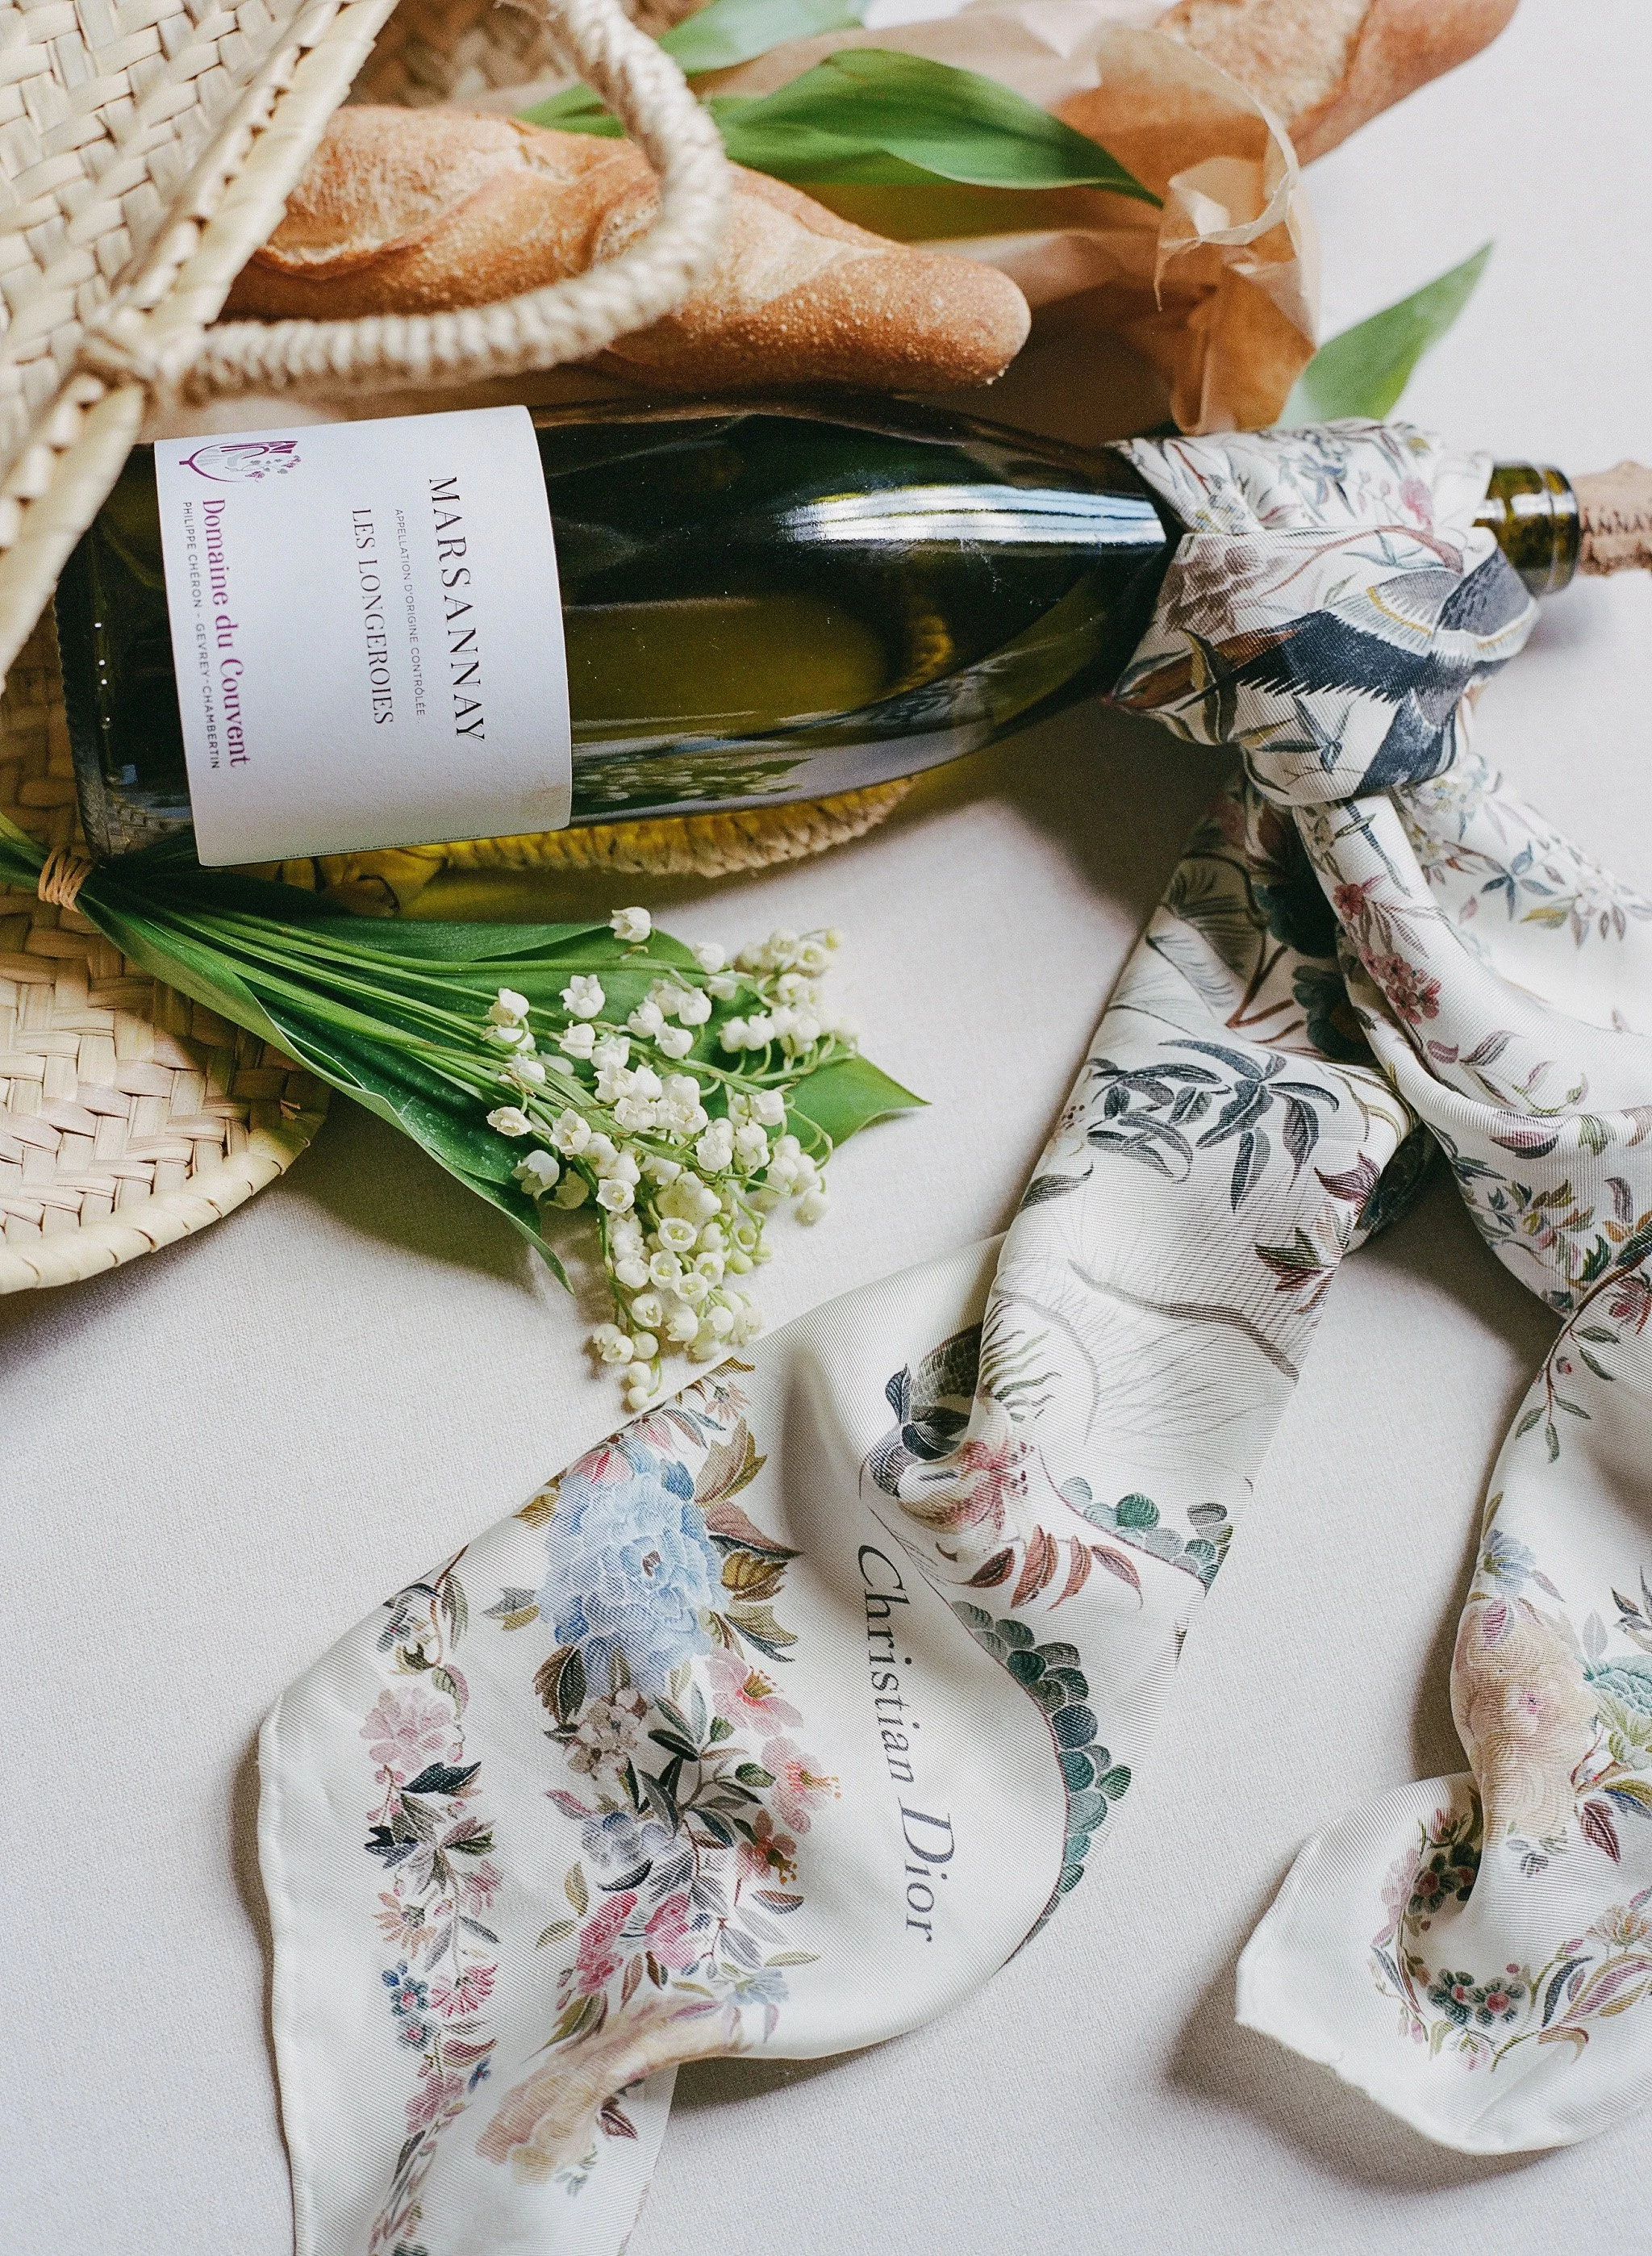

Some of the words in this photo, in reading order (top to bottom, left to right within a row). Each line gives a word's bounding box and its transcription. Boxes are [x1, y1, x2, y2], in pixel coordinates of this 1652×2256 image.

[183, 501, 196, 549] PHILIPPE
[202, 499, 230, 607] Domaine
[352, 508, 376, 549] LES
[187, 554, 202, 608] CHÉRON
[215, 615, 239, 649] du
[395, 509, 411, 581] APPELLATION
[403, 584, 419, 643] D'ORIGINE
[411, 647, 426, 716] CONTRÔLÉE
[428, 476, 486, 741] MARSANNAY
[195, 623, 219, 770] GEVREY-CHAMBERTIN
[357, 558, 394, 725] LONGEROIES
[220, 658, 251, 768] Couvent
[857, 1543, 920, 1783] Christian
[896, 1797, 956, 1944] Dior
